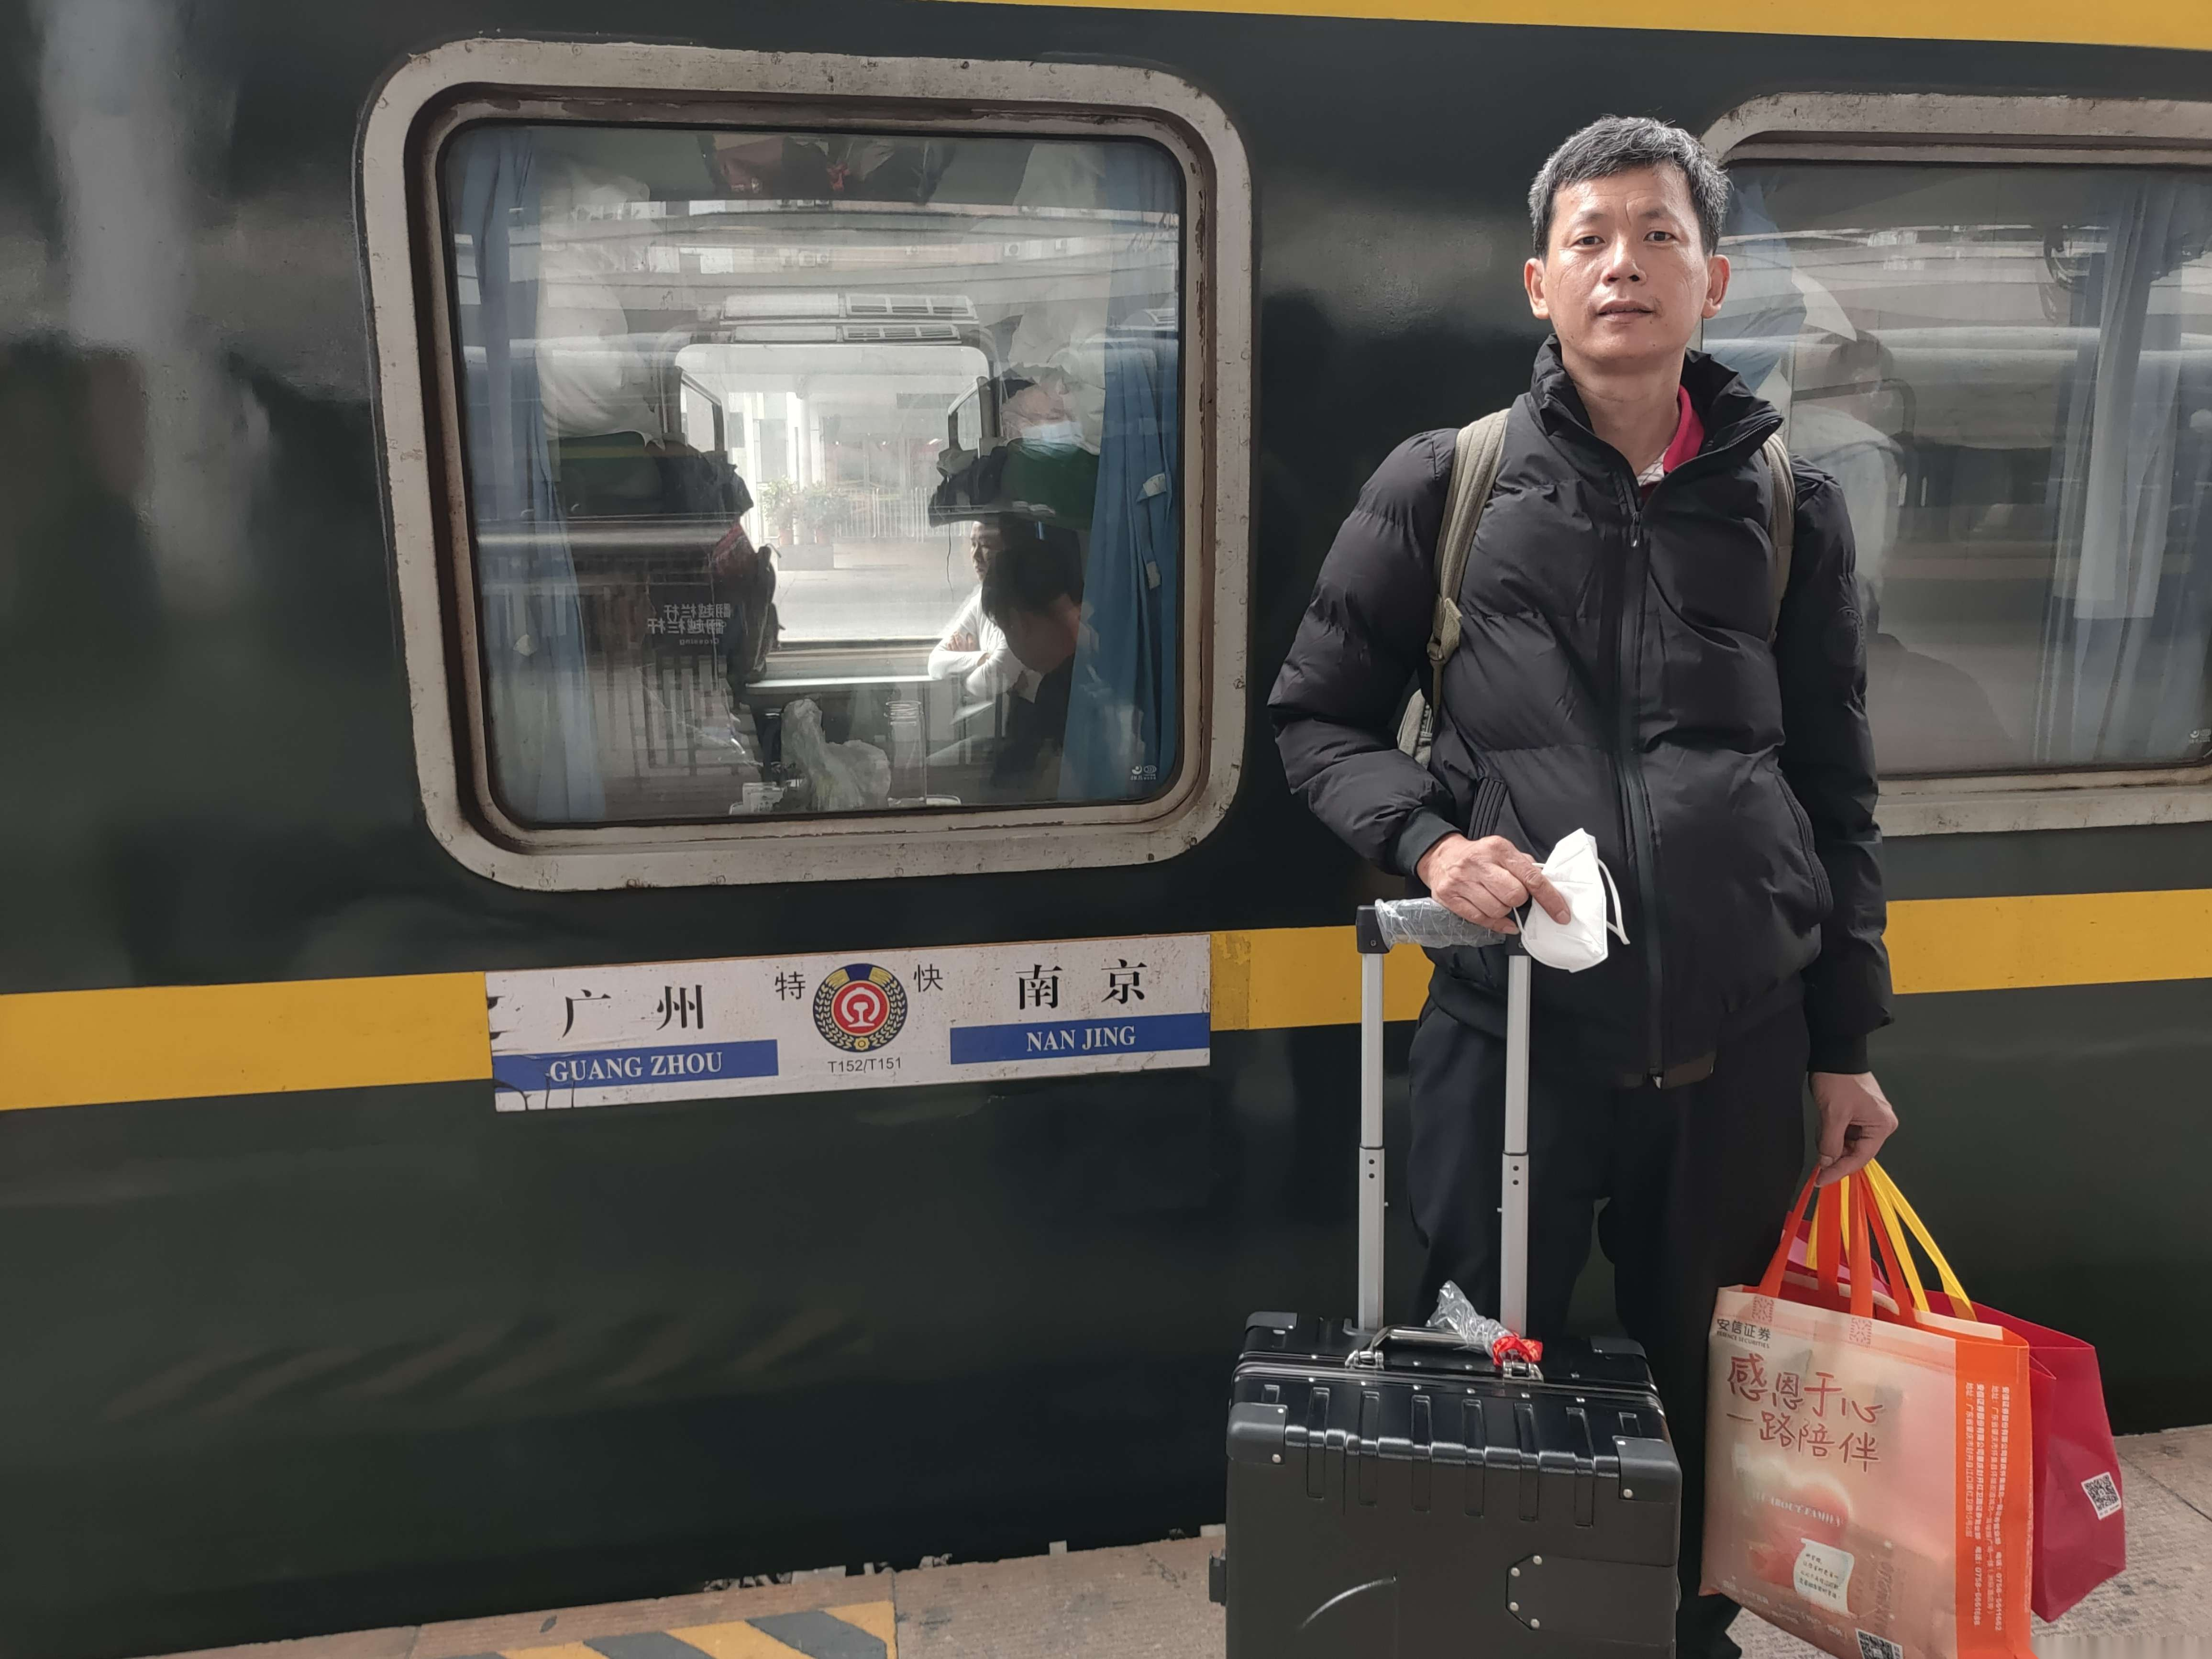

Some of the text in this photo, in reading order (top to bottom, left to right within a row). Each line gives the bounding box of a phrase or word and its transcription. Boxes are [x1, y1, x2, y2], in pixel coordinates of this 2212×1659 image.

[774, 963, 943, 1001] 特 快
[1015, 958, 1148, 1010] 南京
[562, 984, 704, 1038] 广州
[1026, 1025, 1136, 1052] NAN JING
[550, 1051, 723, 1083] GUANG ZHOU
[828, 1057, 901, 1074] T152/T151
[1716, 1318, 1771, 1341] 安信证券
[1727, 1352, 1883, 1423] 感恩于心
[1726, 1410, 1879, 1472] 一路陪伴
